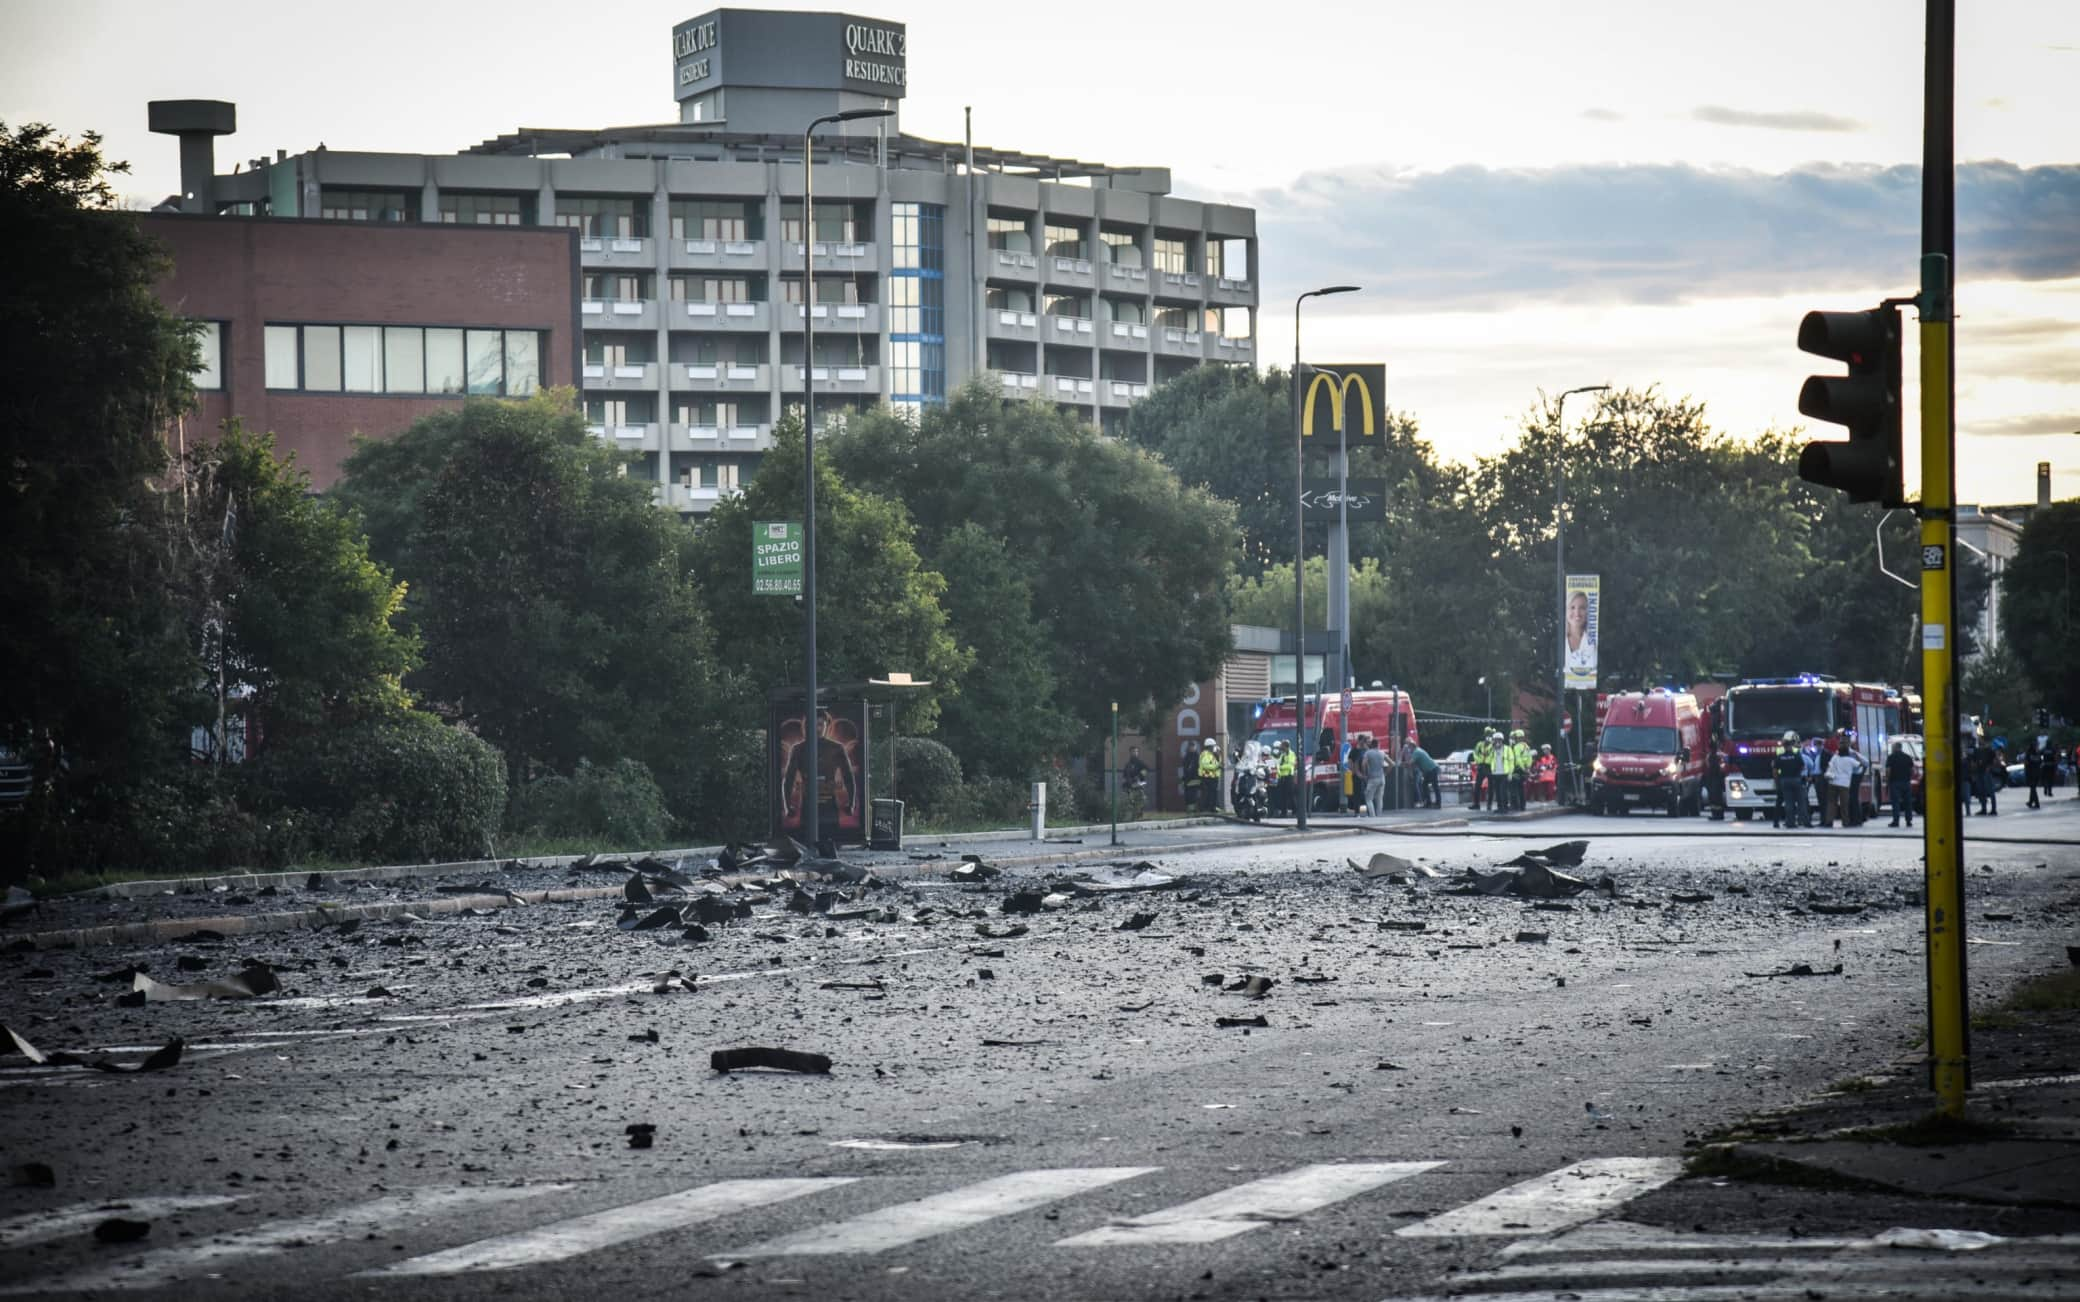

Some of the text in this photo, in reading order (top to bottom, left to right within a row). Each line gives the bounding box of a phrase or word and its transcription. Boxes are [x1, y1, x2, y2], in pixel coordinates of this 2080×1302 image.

[698, 21, 716, 50] DUE
[846, 24, 895, 56] QUARK
[757, 541, 799, 555] SPAZIO
[758, 553, 800, 566] LIBERO
